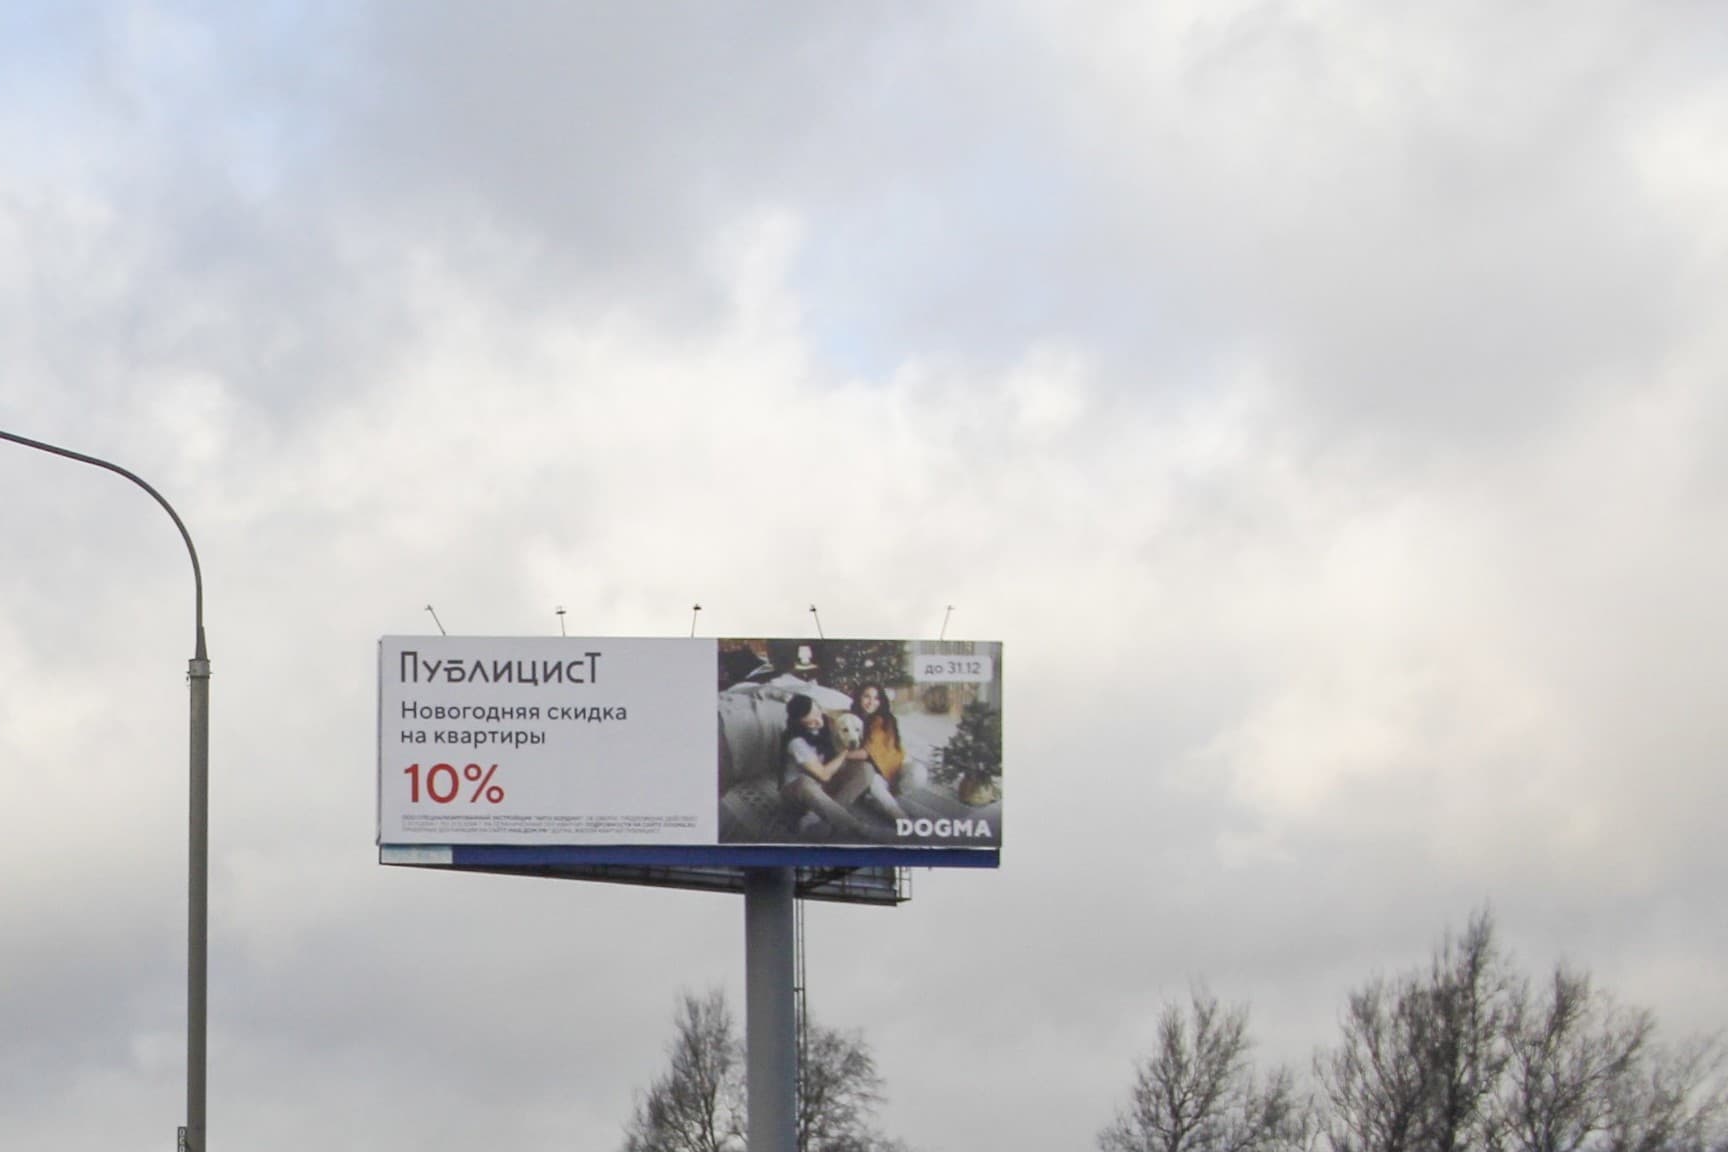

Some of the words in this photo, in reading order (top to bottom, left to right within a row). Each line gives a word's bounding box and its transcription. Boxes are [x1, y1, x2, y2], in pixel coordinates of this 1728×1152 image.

[924, 663, 944, 675] до
[948, 660, 981, 675] 31.12
[401, 700, 541, 722] Новогодняя
[546, 706, 628, 723] скидка
[400, 729, 427, 745] на
[433, 730, 546, 749] квартиры
[404, 763, 505, 804] 10%
[896, 818, 992, 838] DOGMA
